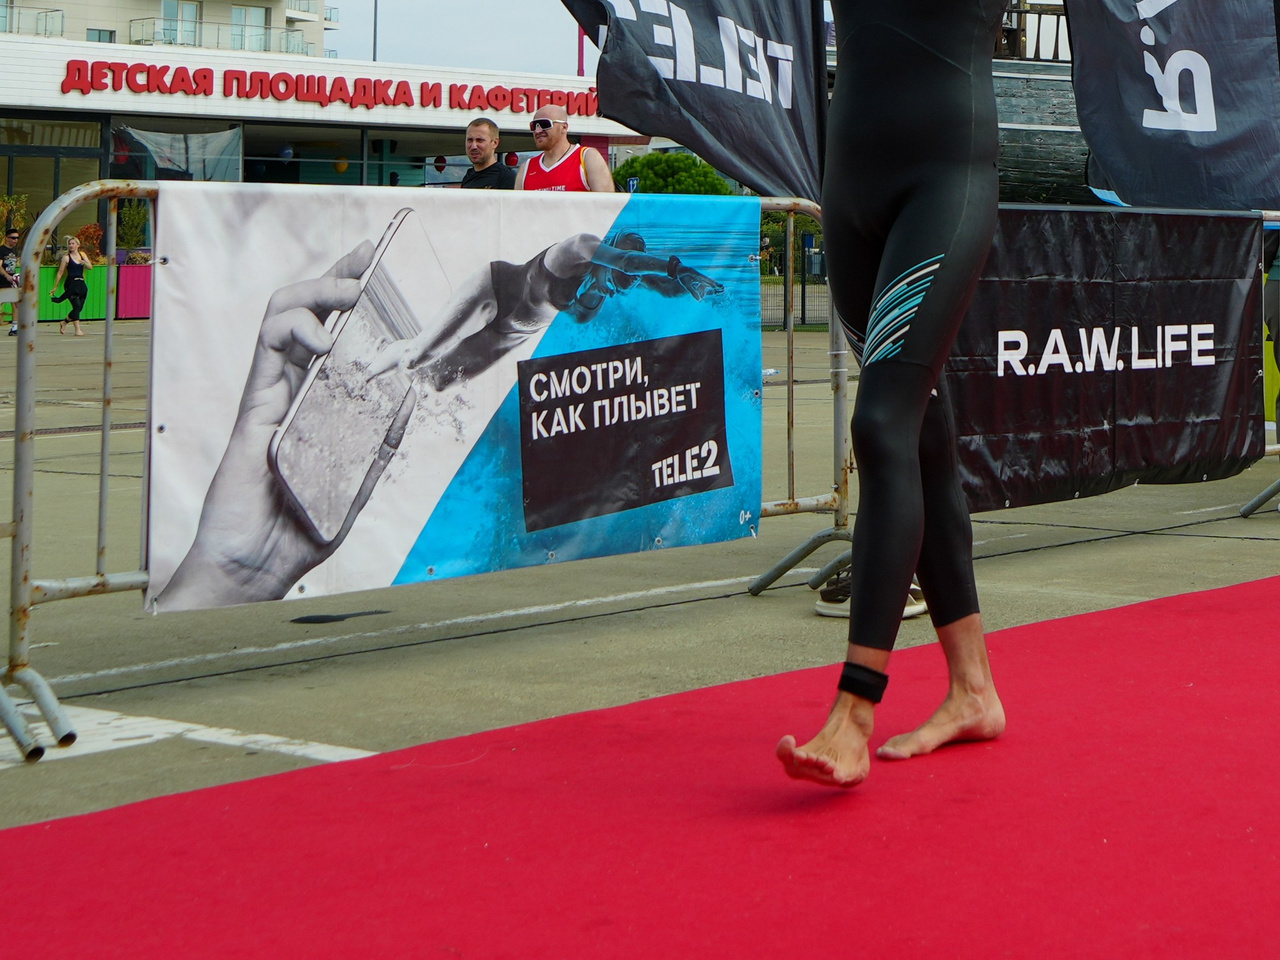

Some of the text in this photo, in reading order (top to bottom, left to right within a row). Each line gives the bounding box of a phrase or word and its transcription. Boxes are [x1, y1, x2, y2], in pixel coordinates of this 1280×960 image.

[61, 59, 214, 96] ДЕТСКАЯ
[223, 69, 415, 110] ПЛОЩАДКА
[420, 81, 443, 108] И
[529, 356, 649, 403] СМОТРИ,
[530, 381, 701, 441] КАК ПЛЫВЕТ
[651, 439, 721, 488] TELE2
